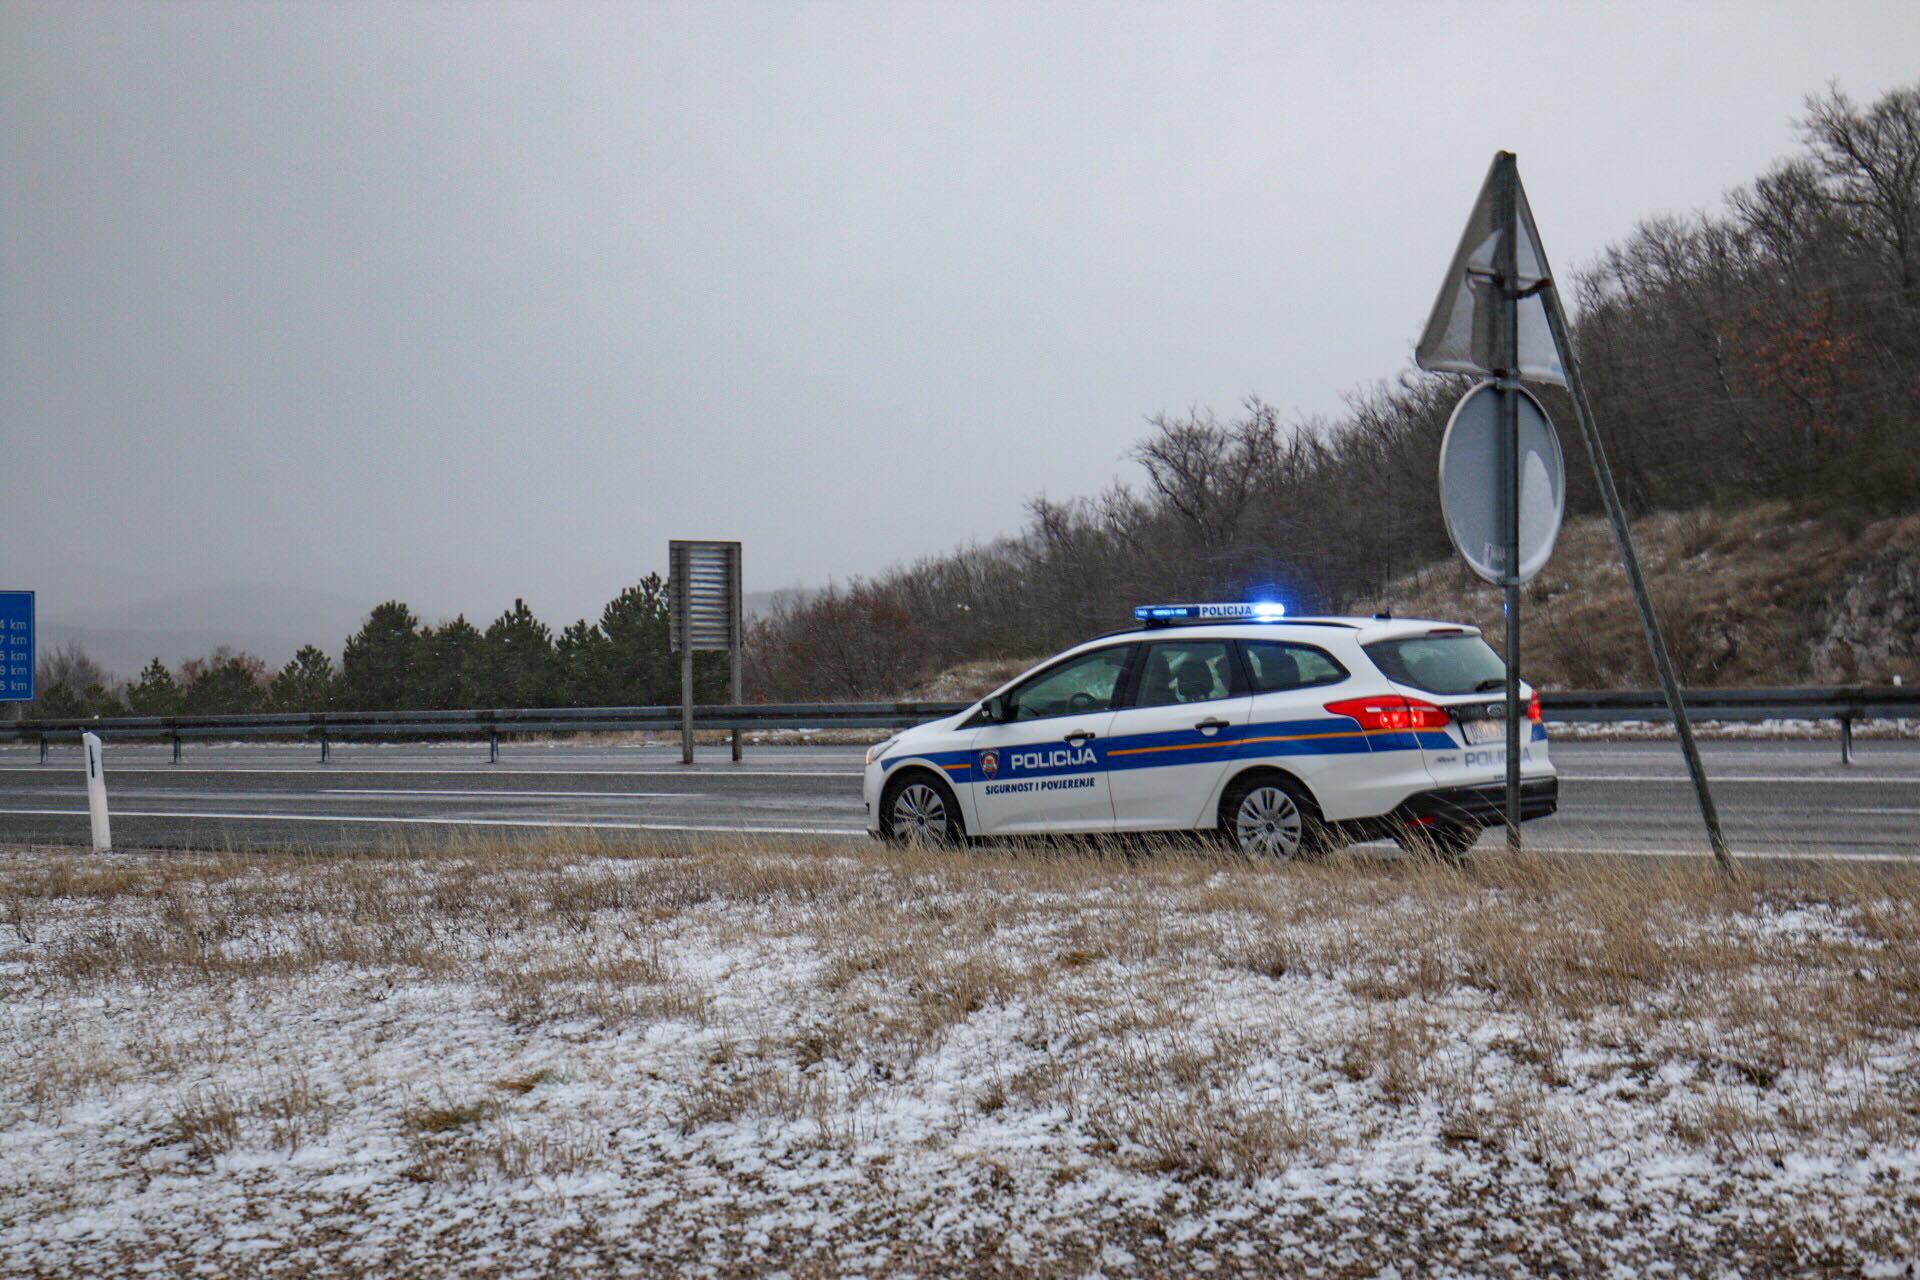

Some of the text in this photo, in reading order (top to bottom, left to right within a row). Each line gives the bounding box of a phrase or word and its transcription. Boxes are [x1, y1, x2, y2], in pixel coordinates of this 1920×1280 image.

[1202, 605, 1252, 616] POLICIJA
[10, 618, 27, 630] km
[10, 633, 27, 644] km
[10, 649, 27, 661] km
[10, 664, 28, 675] km
[10, 679, 28, 691] km
[1010, 748, 1098, 770] POLICIJA
[1464, 746, 1532, 768] POLIA
[985, 777, 1096, 795] SIGURNOST I POVJERENJE
